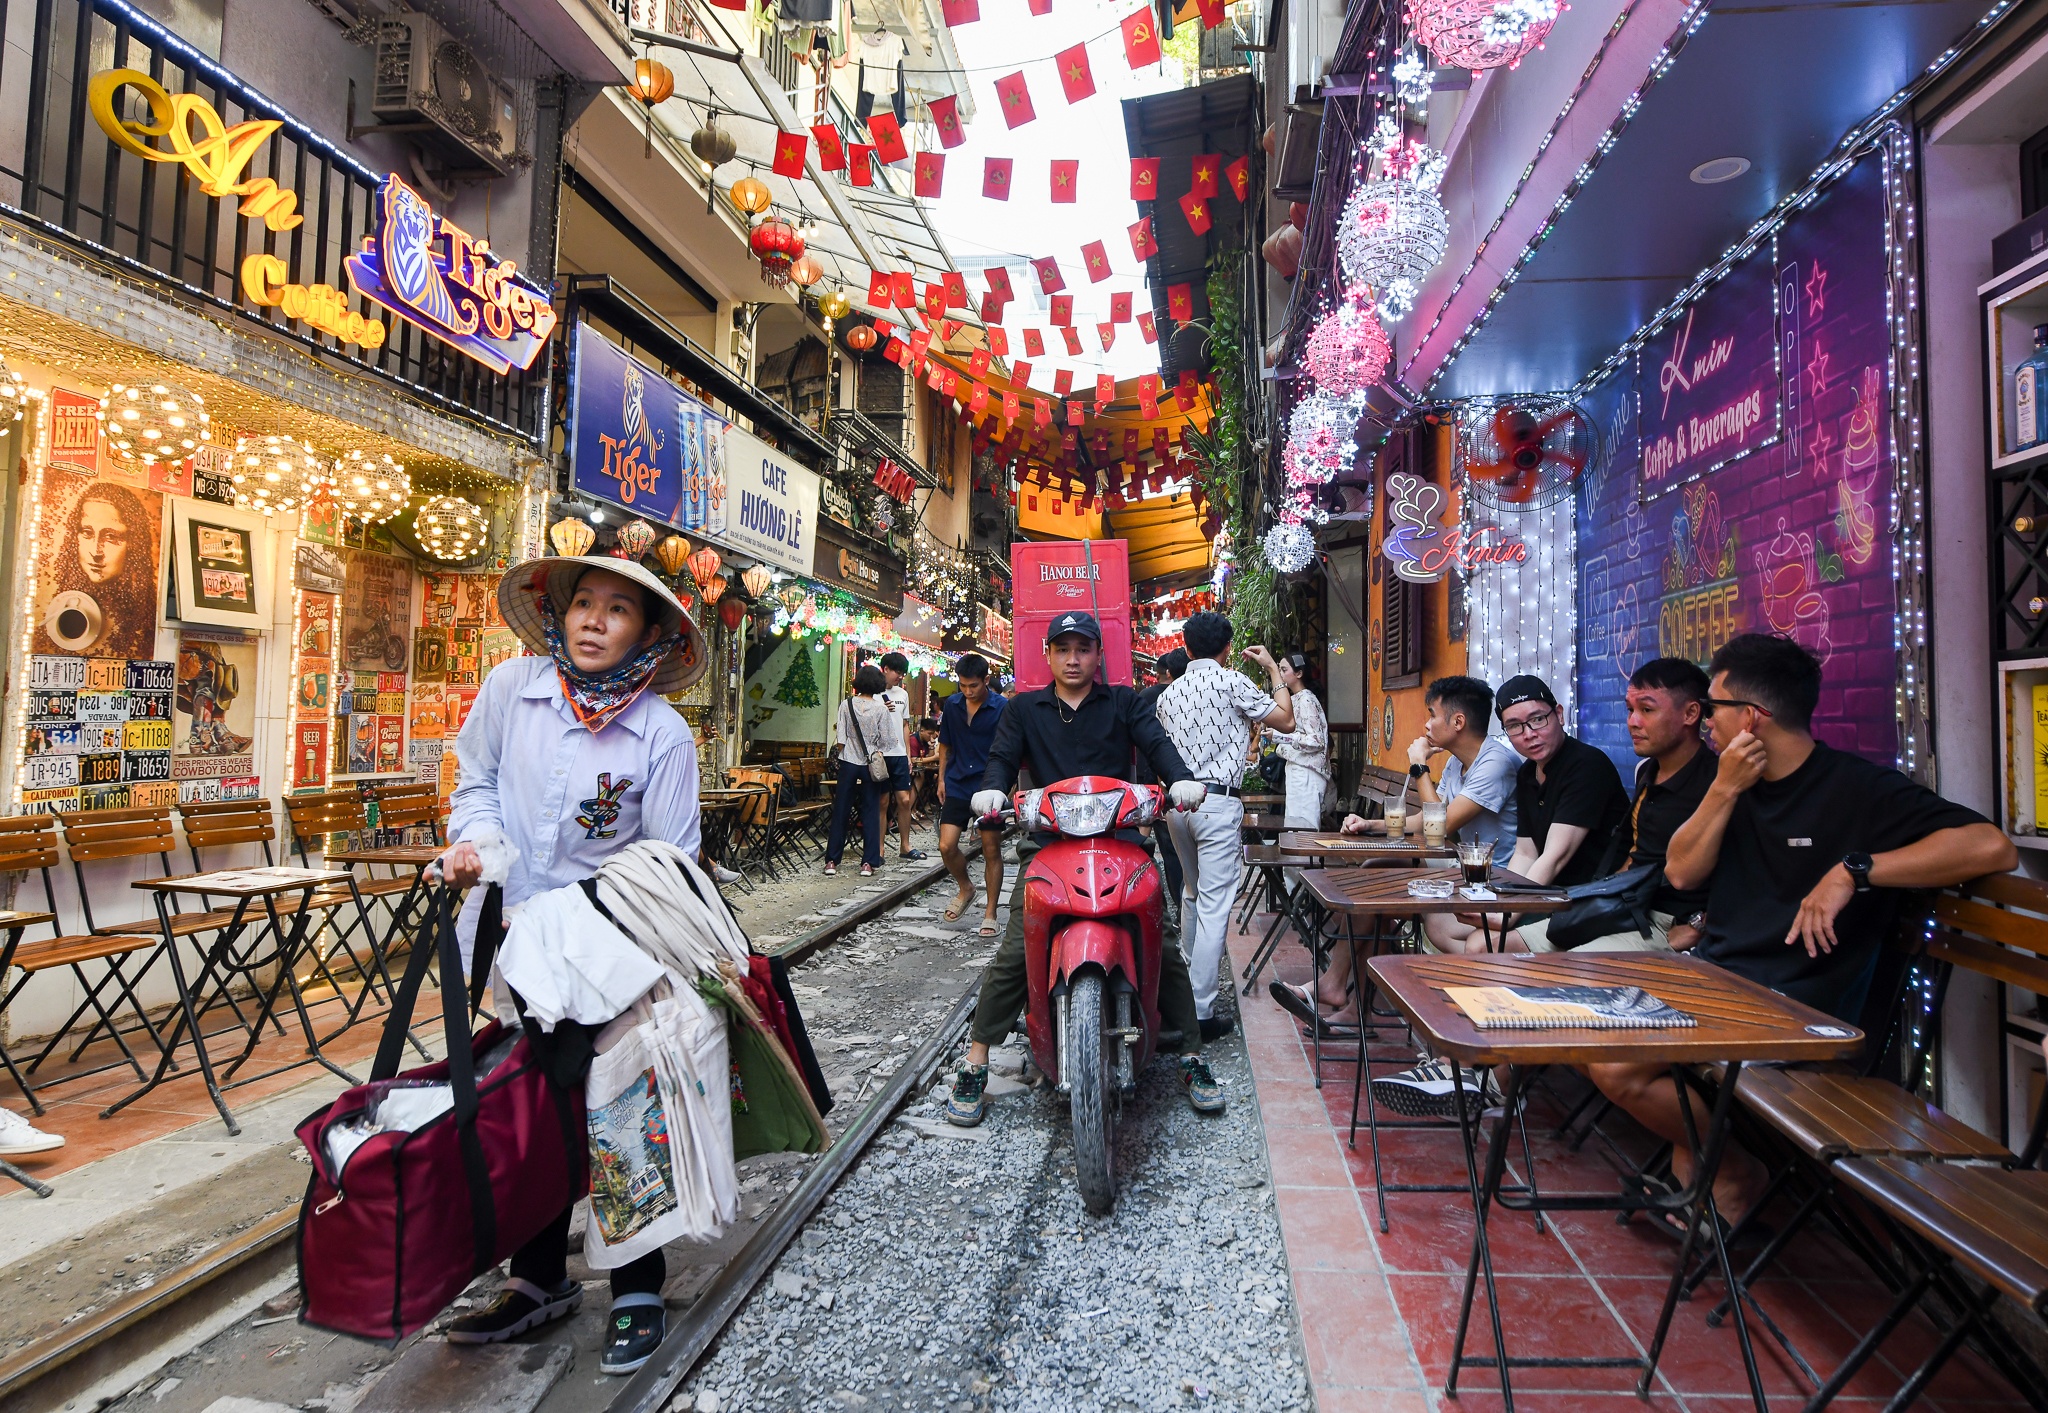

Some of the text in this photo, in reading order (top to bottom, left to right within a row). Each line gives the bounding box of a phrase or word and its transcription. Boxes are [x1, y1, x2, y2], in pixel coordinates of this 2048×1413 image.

[439, 218, 554, 340] Tiger
[241, 253, 386, 348] Coffee
[1660, 307, 1735, 421] Kmin
[1784, 281, 1799, 461] OPEN
[55, 404, 97, 417] FREE
[54, 416, 97, 448] BEER
[1644, 389, 1761, 480] Coffe & Beverages
[196, 448, 211, 468] USA
[599, 432, 662, 503] Tiger
[196, 477, 206, 494] MB
[762, 458, 787, 496] CAFE
[822, 477, 852, 516] Carlsberg
[740, 489, 786, 542] HƯƠNG
[787, 509, 802, 550] LÊ
[1421, 527, 1527, 572] Kmin
[353, 553, 405, 571] AMERICAN
[363, 565, 395, 579] DREAM
[442, 576, 456, 584] ZONE
[860, 560, 880, 584] House
[1040, 563, 1074, 582] HANOI
[307, 606, 329, 618] Beer
[398, 601, 406, 610] TO
[438, 607, 451, 618] PUB
[1659, 584, 1739, 662] COFFEE
[181, 631, 203, 640] FORGET
[216, 634, 235, 642] GLASS
[235, 635, 258, 644] SLIPPER
[1587, 623, 1606, 643] Coffee
[360, 676, 374, 688] STYLE
[392, 674, 405, 689] 1929
[412, 684, 442, 701] Beer
[29, 697, 48, 716] BUS
[79, 695, 128, 711] 1234 ABC
[130, 697, 147, 716] 926
[360, 695, 376, 711] 1889
[51, 729, 81, 746] 521
[303, 731, 320, 743] BEER
[380, 728, 401, 740] Beer
[426, 744, 443, 756] 1929
[31, 761, 72, 781] IR-945
[92, 759, 119, 782] 1889
[173, 764, 252, 777] COWBOY BOOTS
[191, 758, 227, 767] PRINCESS
[227, 757, 252, 765] WEARS
[349, 762, 374, 773] HOPE
[30, 788, 75, 801] CALIFORNIA
[103, 791, 129, 809] 1889
[203, 785, 220, 801] 1854
[22, 798, 78, 816] KLM 789
[608, 1092, 632, 1119] TRAIN
[612, 1107, 636, 1135] STREET
